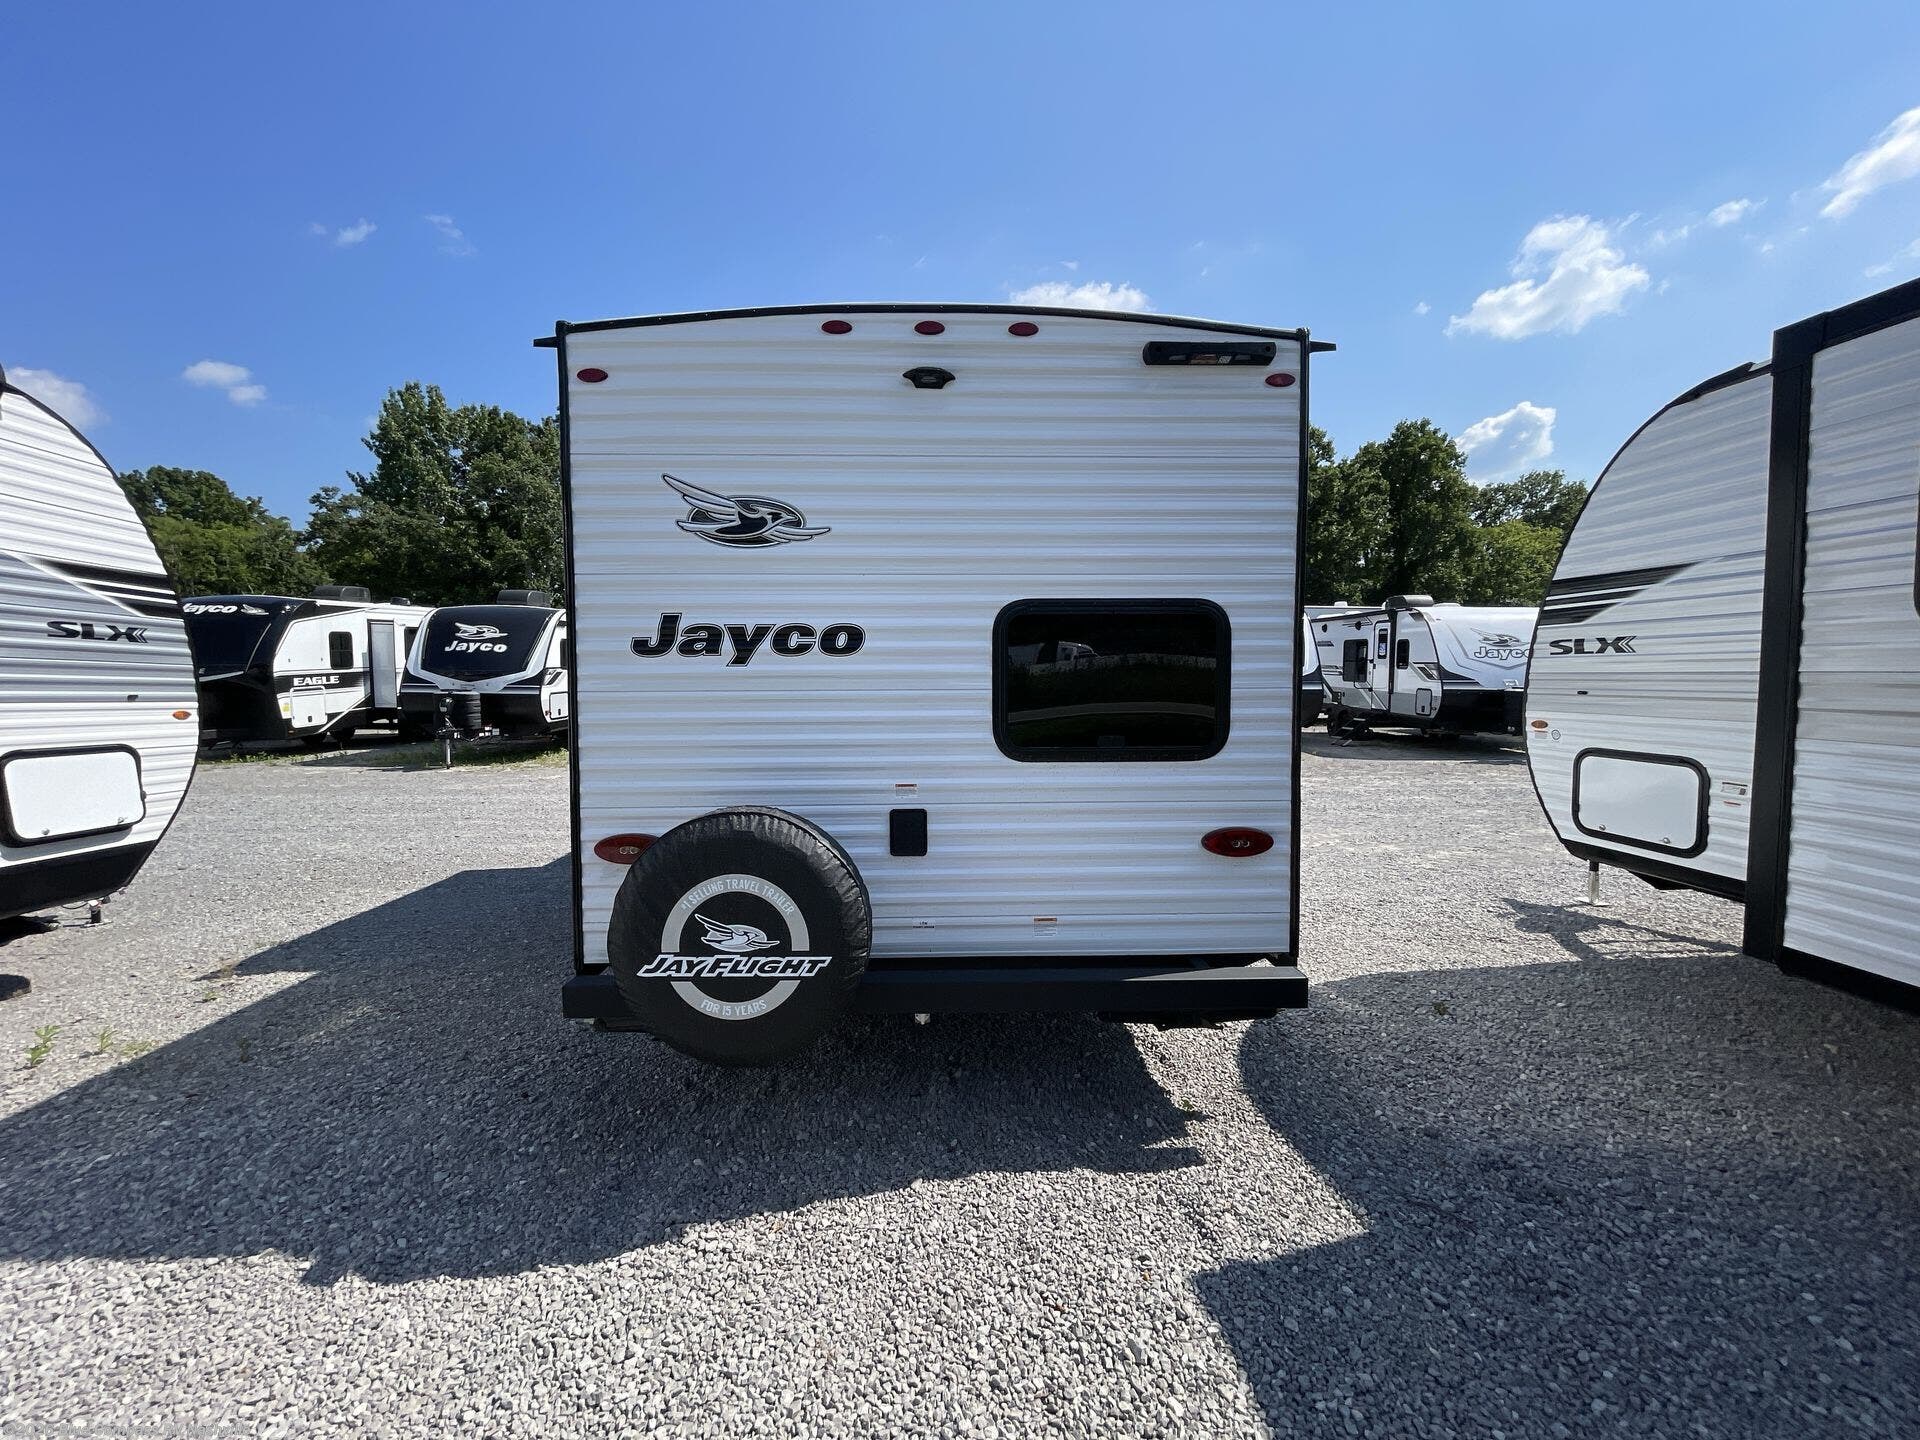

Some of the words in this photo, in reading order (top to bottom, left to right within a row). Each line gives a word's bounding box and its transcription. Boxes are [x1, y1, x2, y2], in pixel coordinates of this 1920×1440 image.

[47, 621, 148, 643] SLX
[631, 612, 866, 667] Jayco
[444, 640, 508, 653] Jayco
[1550, 635, 1637, 655] SLX
[293, 675, 340, 687] EAGLE
[688, 881, 724, 904] SELLING
[726, 879, 760, 893] TRAVEL
[762, 886, 795, 916] TRAILER
[700, 999, 721, 1014] FOR
[722, 1005, 732, 1016] 15
[734, 999, 767, 1016] YEARS
